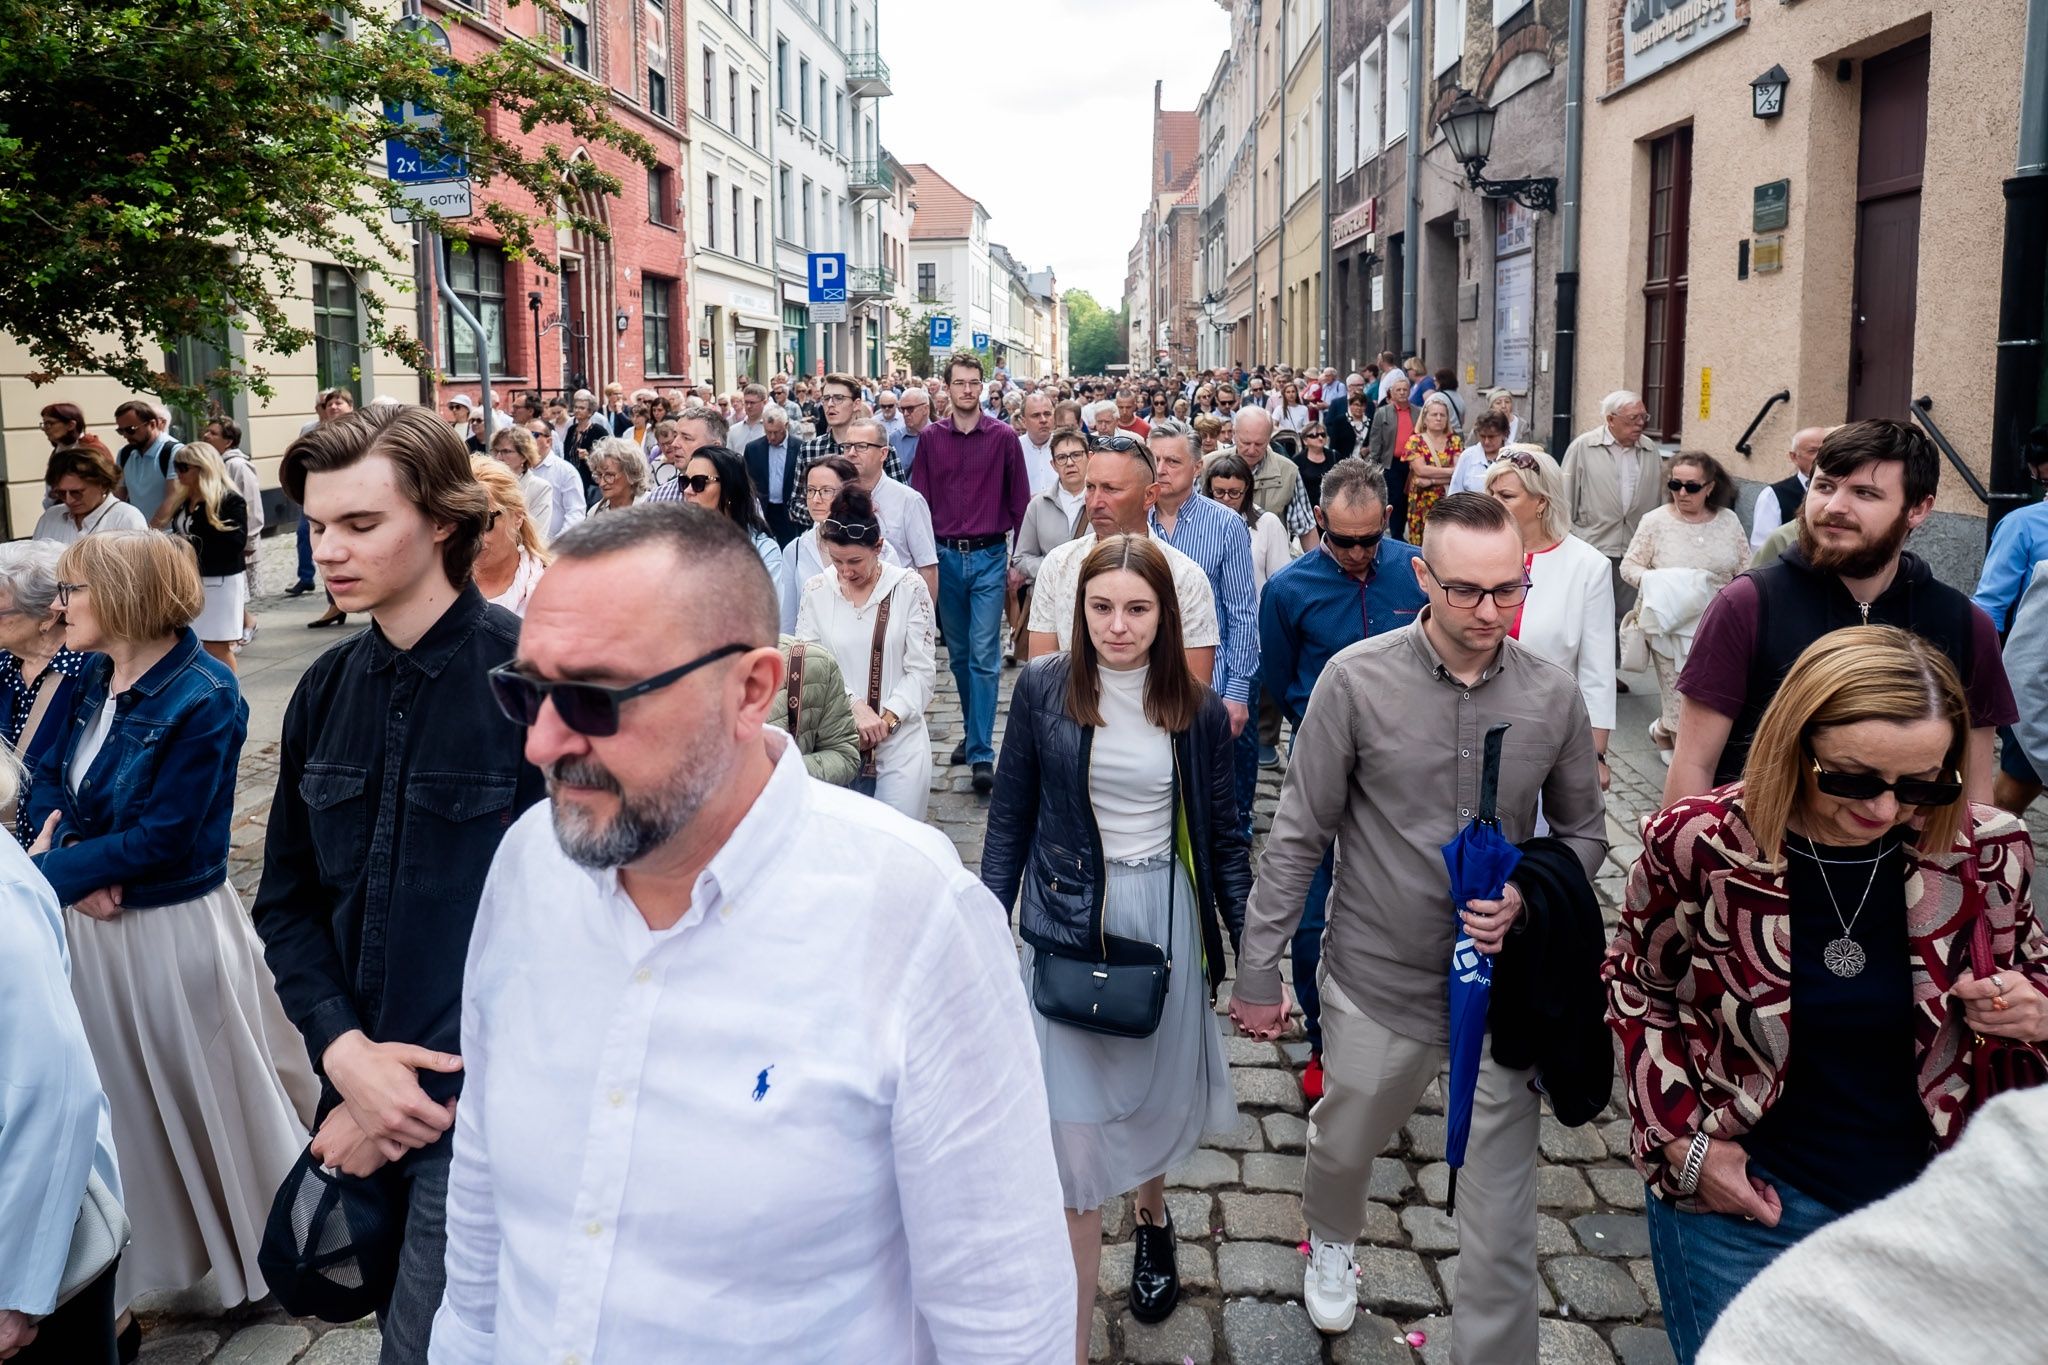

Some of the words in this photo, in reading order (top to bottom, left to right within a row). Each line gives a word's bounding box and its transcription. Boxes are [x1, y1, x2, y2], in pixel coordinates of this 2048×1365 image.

[396, 157, 416, 174] 2x
[429, 193, 466, 206] GOTYK
[816, 257, 838, 288] P
[935, 320, 948, 338] P
[976, 336, 986, 348] P
